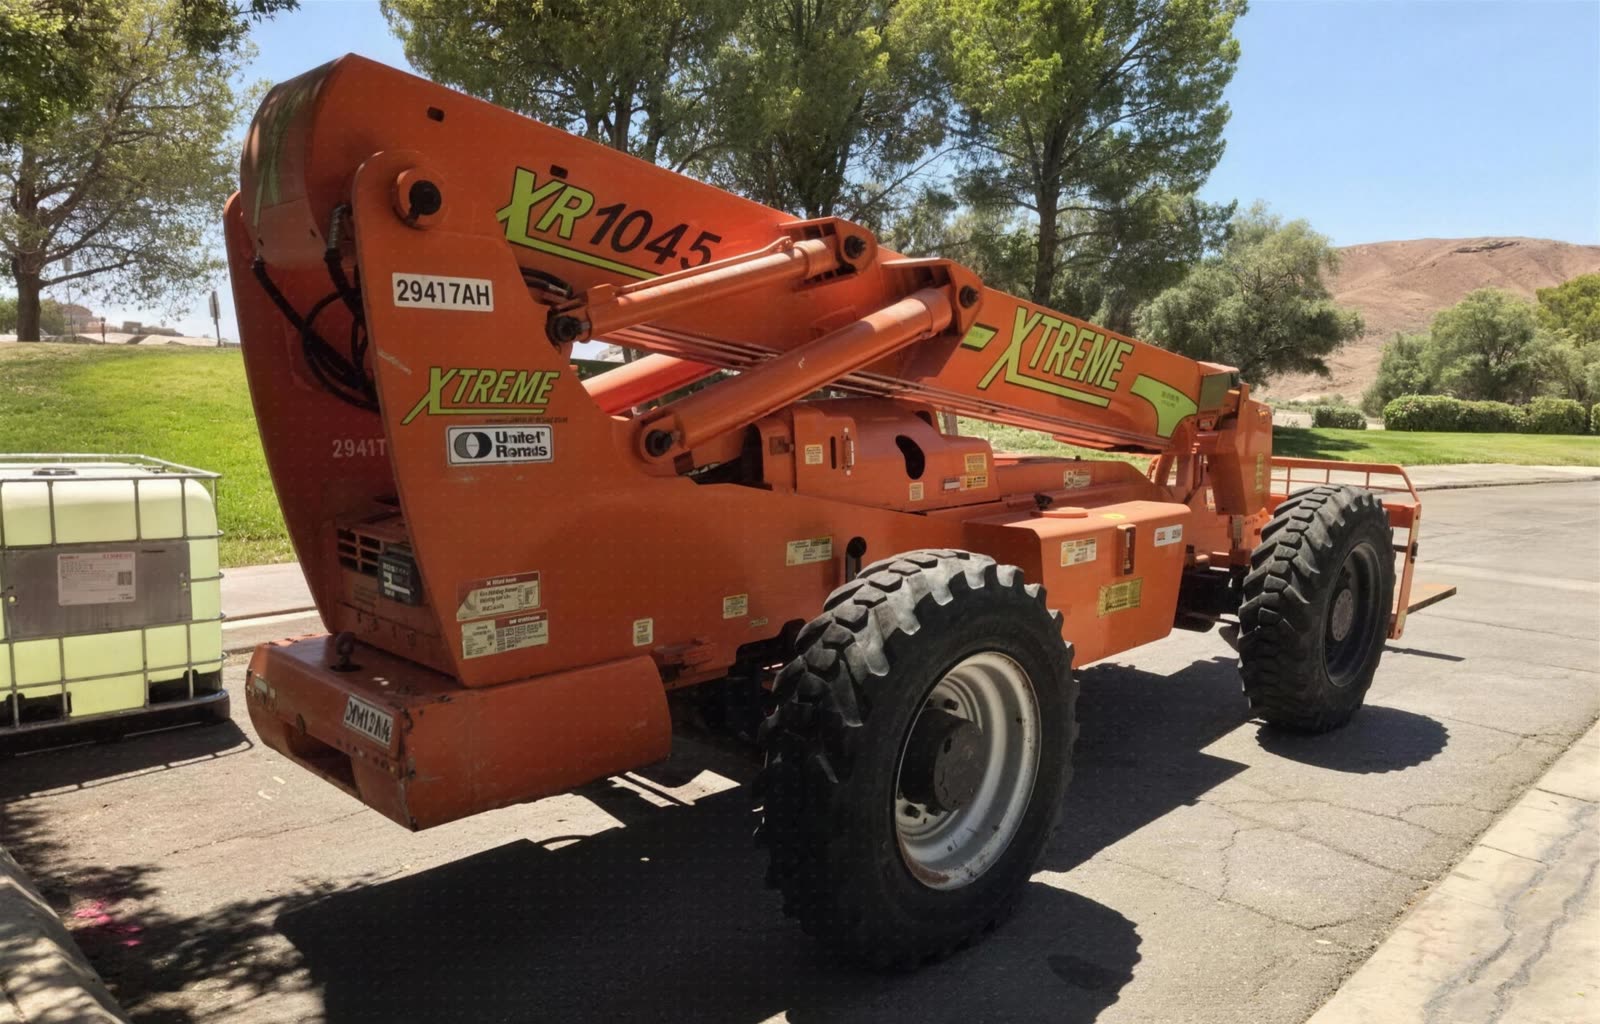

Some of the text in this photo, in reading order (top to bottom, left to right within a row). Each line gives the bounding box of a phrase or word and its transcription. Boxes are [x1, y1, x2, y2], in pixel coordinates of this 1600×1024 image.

[396, 279, 490, 306] 29417AH
[977, 306, 1134, 408] XTREME
[400, 367, 560, 425] XTREME
